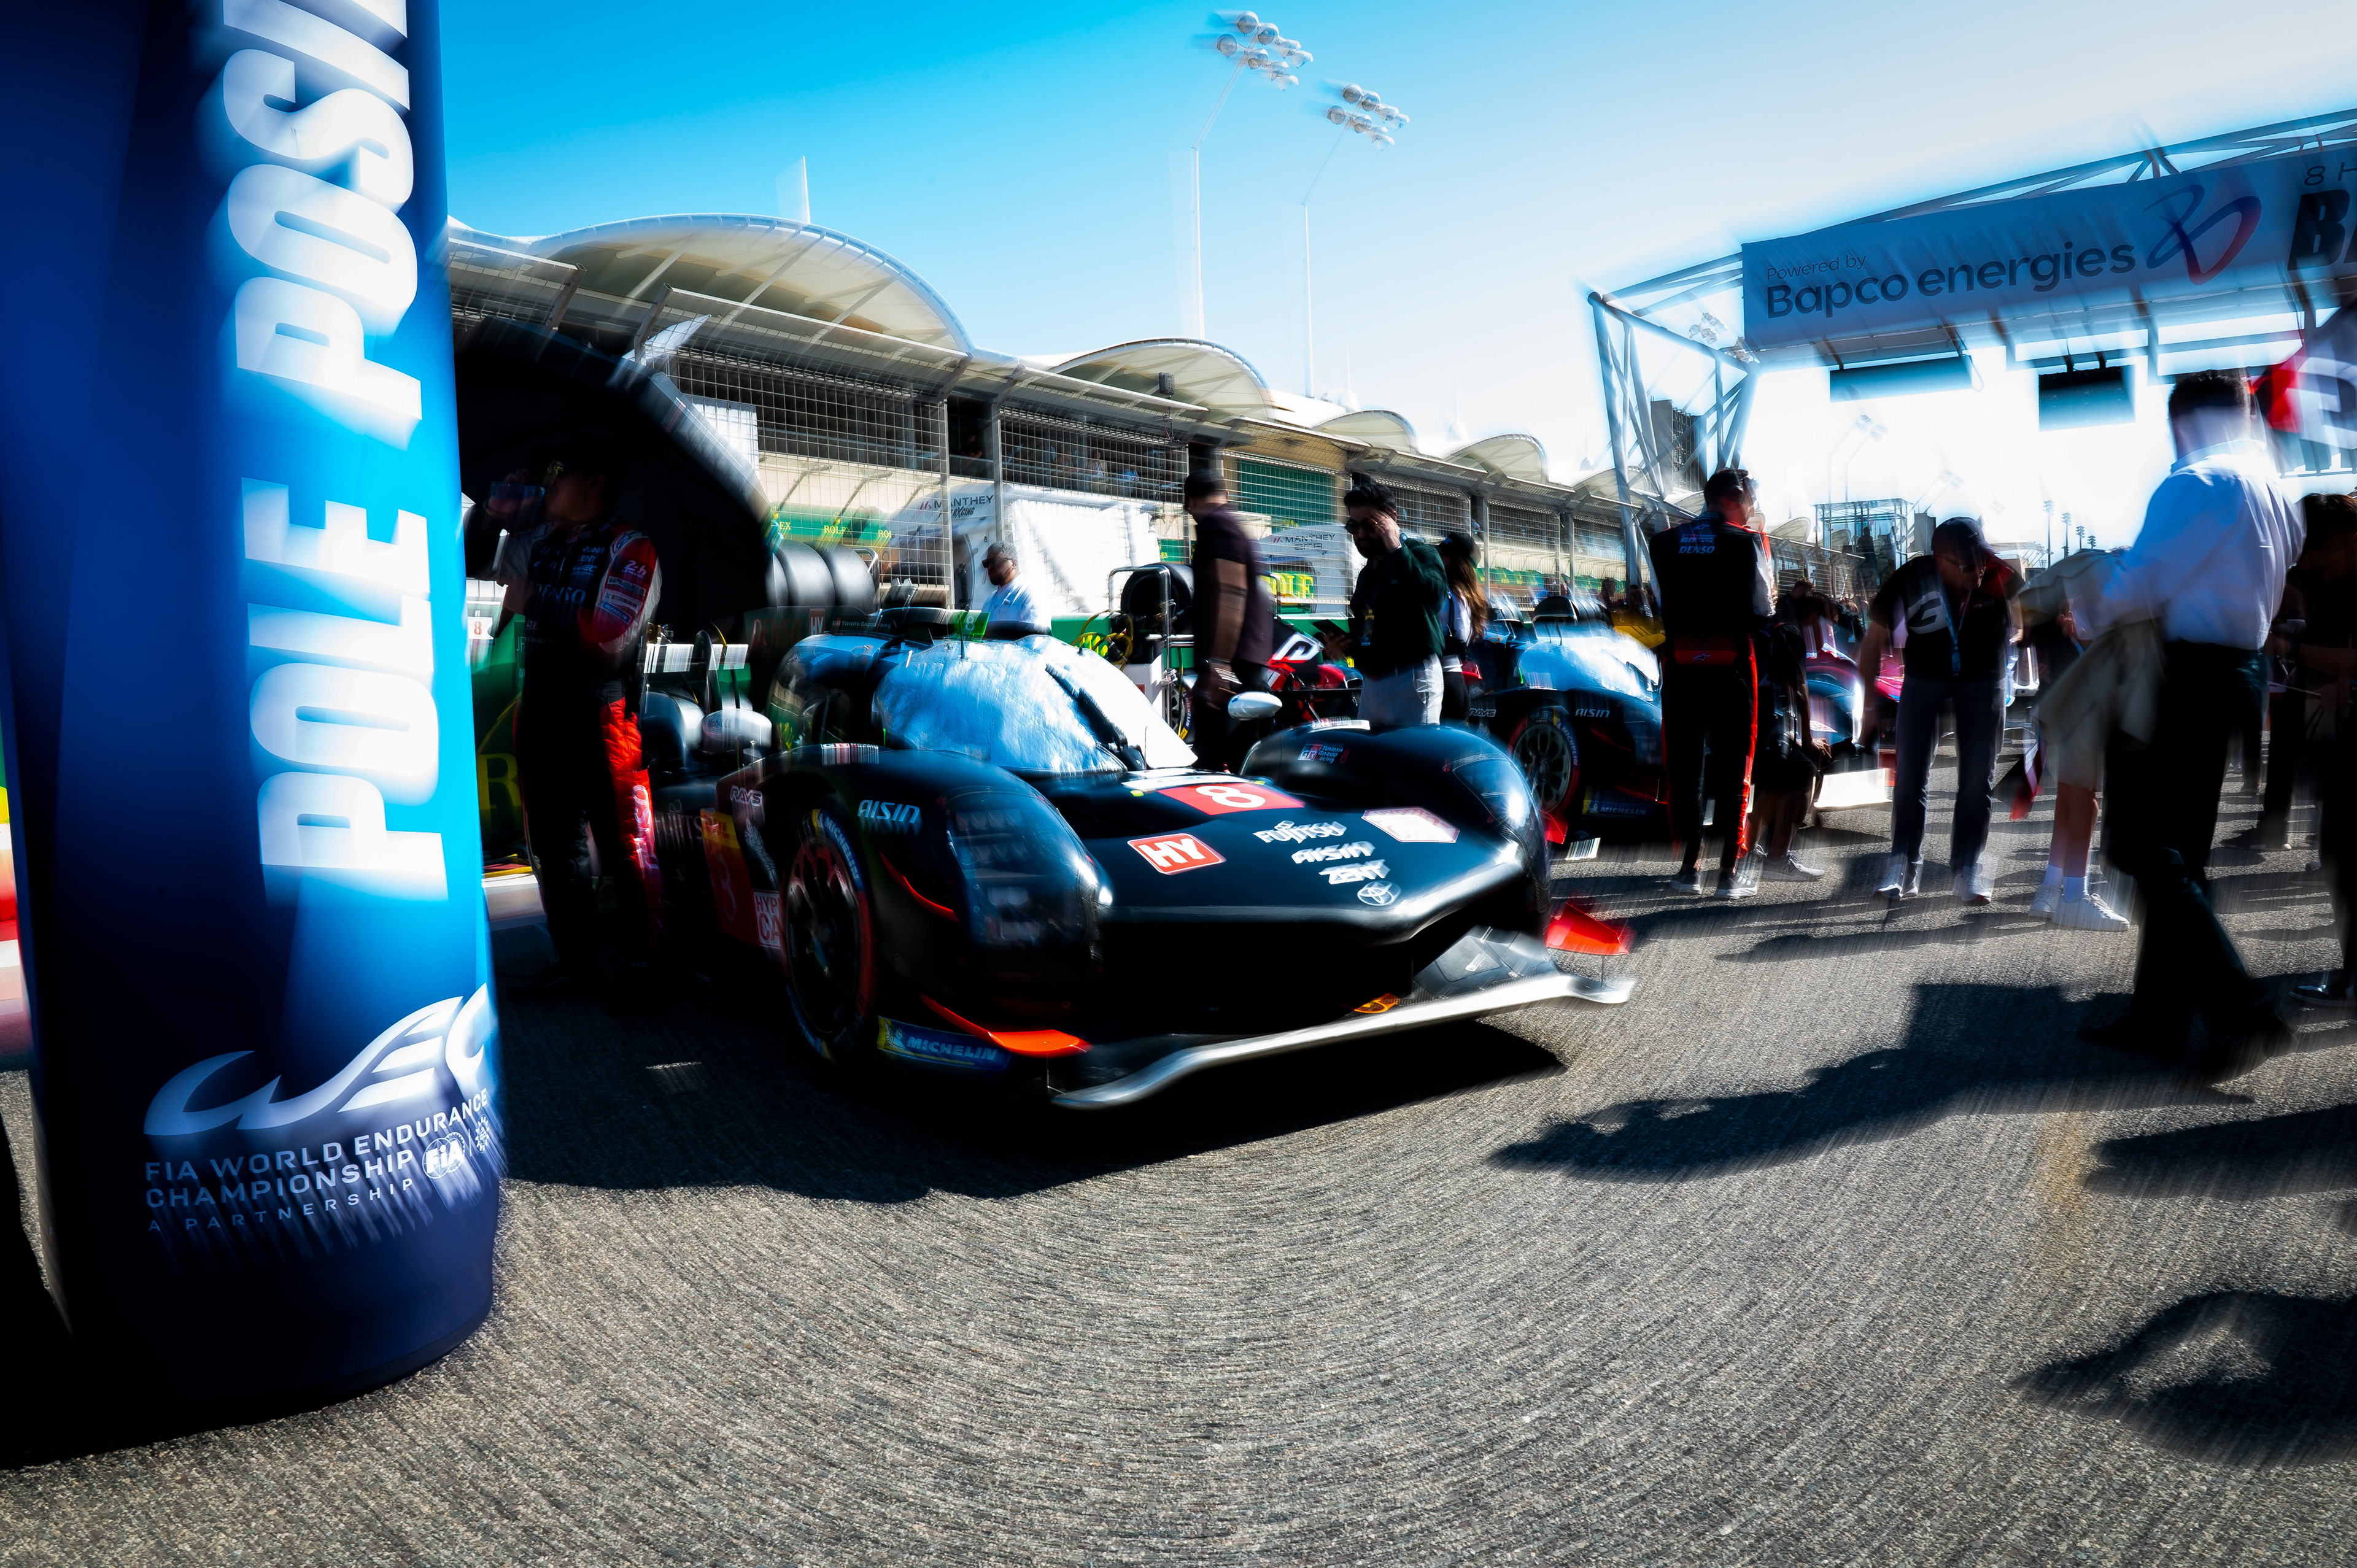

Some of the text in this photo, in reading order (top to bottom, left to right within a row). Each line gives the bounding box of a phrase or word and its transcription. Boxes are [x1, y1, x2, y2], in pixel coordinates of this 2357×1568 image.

[1767, 255, 1866, 280] Powered by
[1767, 241, 2136, 319] Bapco energies
[1285, 534, 1336, 543] MANTHEY
[242, 476, 447, 890] POLE
[1196, 786, 1266, 808] 8
[1600, 806, 1647, 815] MICHELIN
[857, 799, 922, 827] AISIN
[1252, 821, 1347, 844] FUJITSU
[824, 816, 860, 880] MICHELIN
[1138, 838, 1207, 868] HY
[1291, 841, 1376, 864] AISIN
[1318, 859, 1391, 885] ZENT
[907, 1036, 998, 1060] MICHELIN
[145, 1161, 198, 1181] FIA
[210, 1142, 343, 1178] WORLD
[354, 1088, 488, 1156] ENDURANCE
[146, 1149, 413, 1208] CHAMPIONSHIP
[149, 1178, 412, 1231] A PARTNERSHIP
